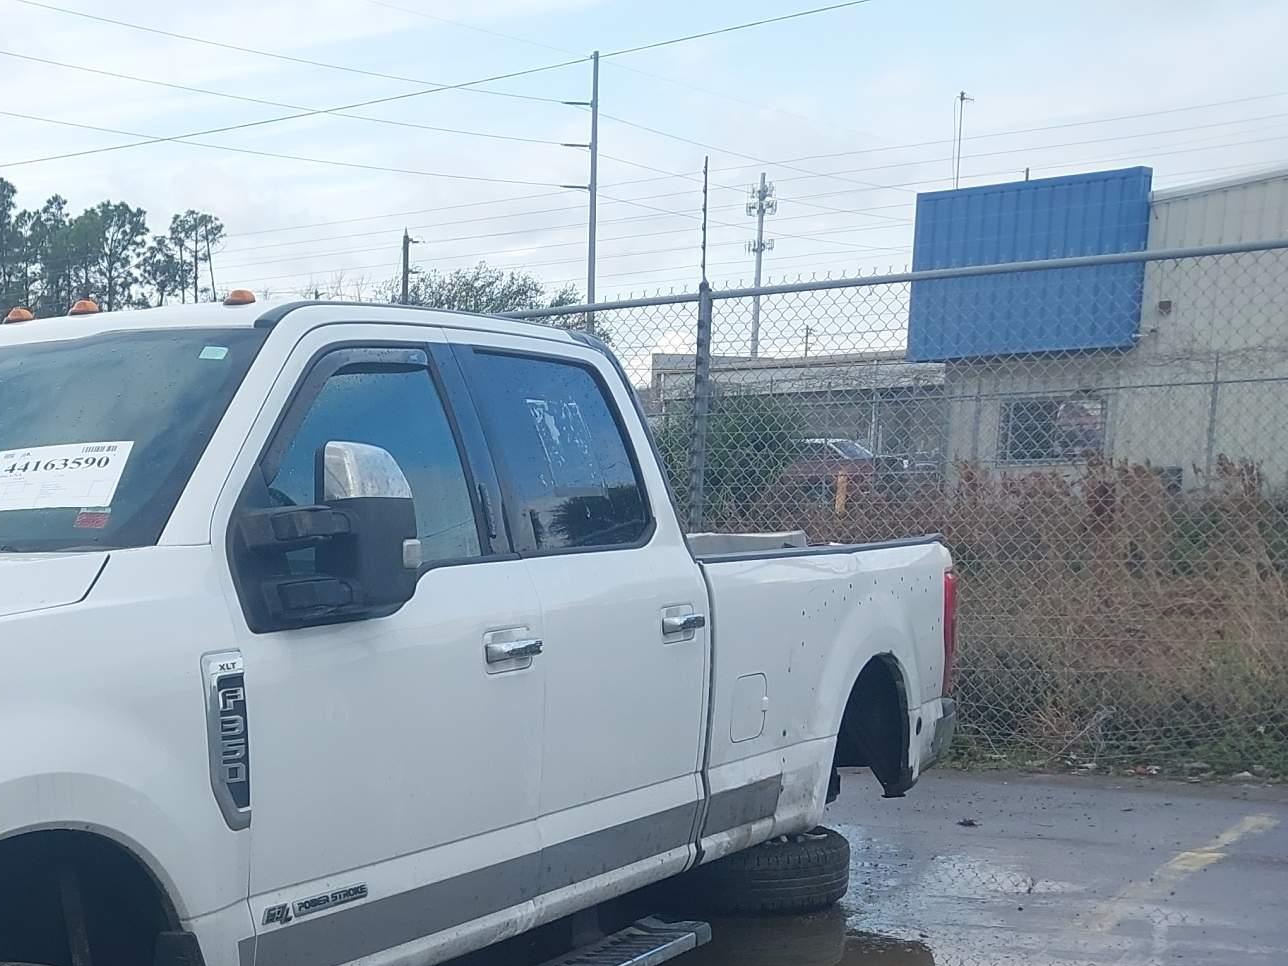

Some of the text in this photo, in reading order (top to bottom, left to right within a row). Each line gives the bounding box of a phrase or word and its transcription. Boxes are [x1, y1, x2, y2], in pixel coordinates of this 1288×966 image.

[4, 455, 110, 474] 44163590
[218, 662, 237, 671] XLT
[297, 895, 330, 912] POWER
[330, 884, 368, 902] STROKE
